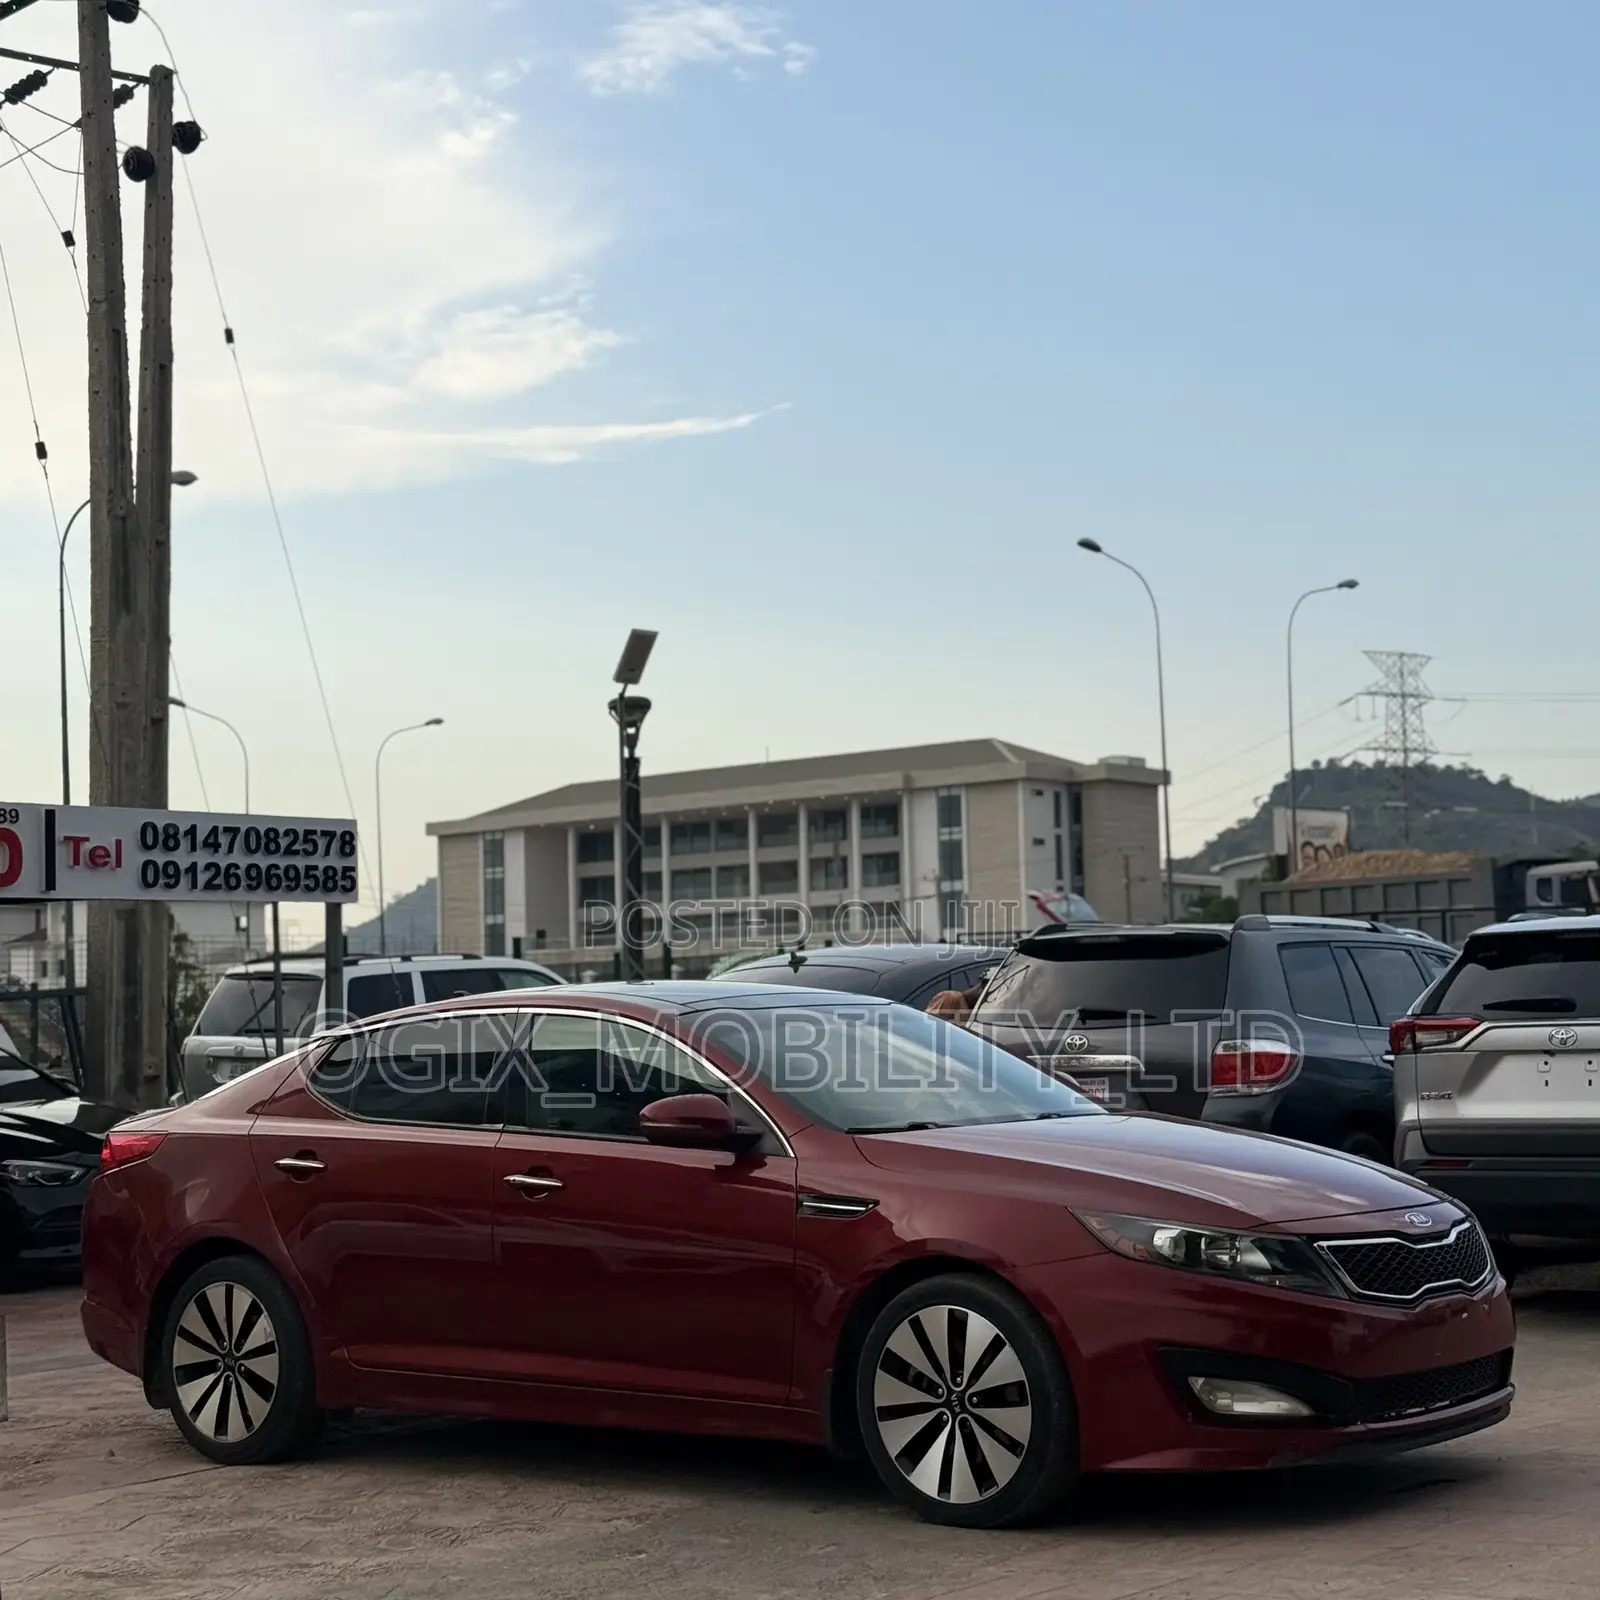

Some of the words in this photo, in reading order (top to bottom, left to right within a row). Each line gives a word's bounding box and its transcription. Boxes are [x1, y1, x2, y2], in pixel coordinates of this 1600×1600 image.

[62, 835, 123, 869] Tel
[139, 821, 356, 858] 08147082578
[140, 859, 357, 893] 09126969585
